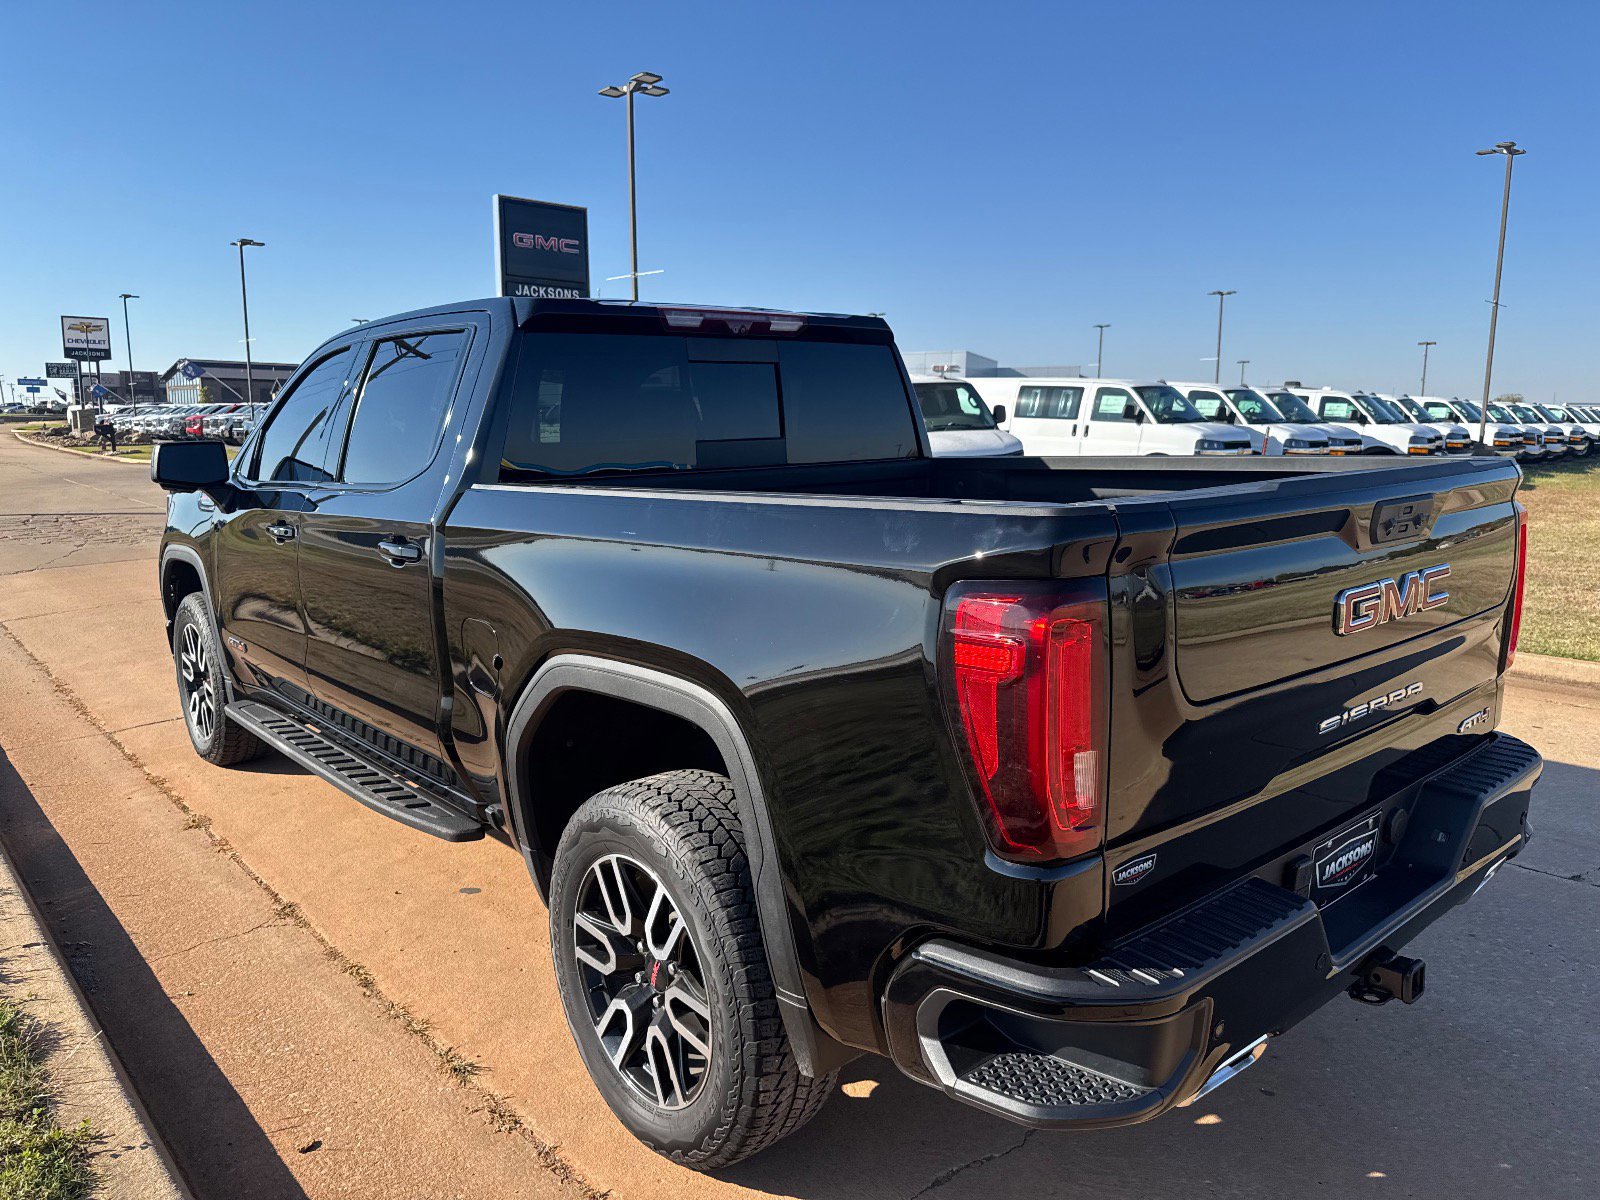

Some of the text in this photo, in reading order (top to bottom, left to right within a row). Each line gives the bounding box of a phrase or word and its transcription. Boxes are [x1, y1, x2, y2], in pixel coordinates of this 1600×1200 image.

[513, 232, 580, 254] GMC
[515, 283, 580, 299] JACKSONS
[1333, 563, 1451, 636] GMC
[1318, 681, 1424, 735] SIERRA
[1117, 859, 1153, 882] JACKSONS
[1322, 839, 1373, 881] JACKSONS
